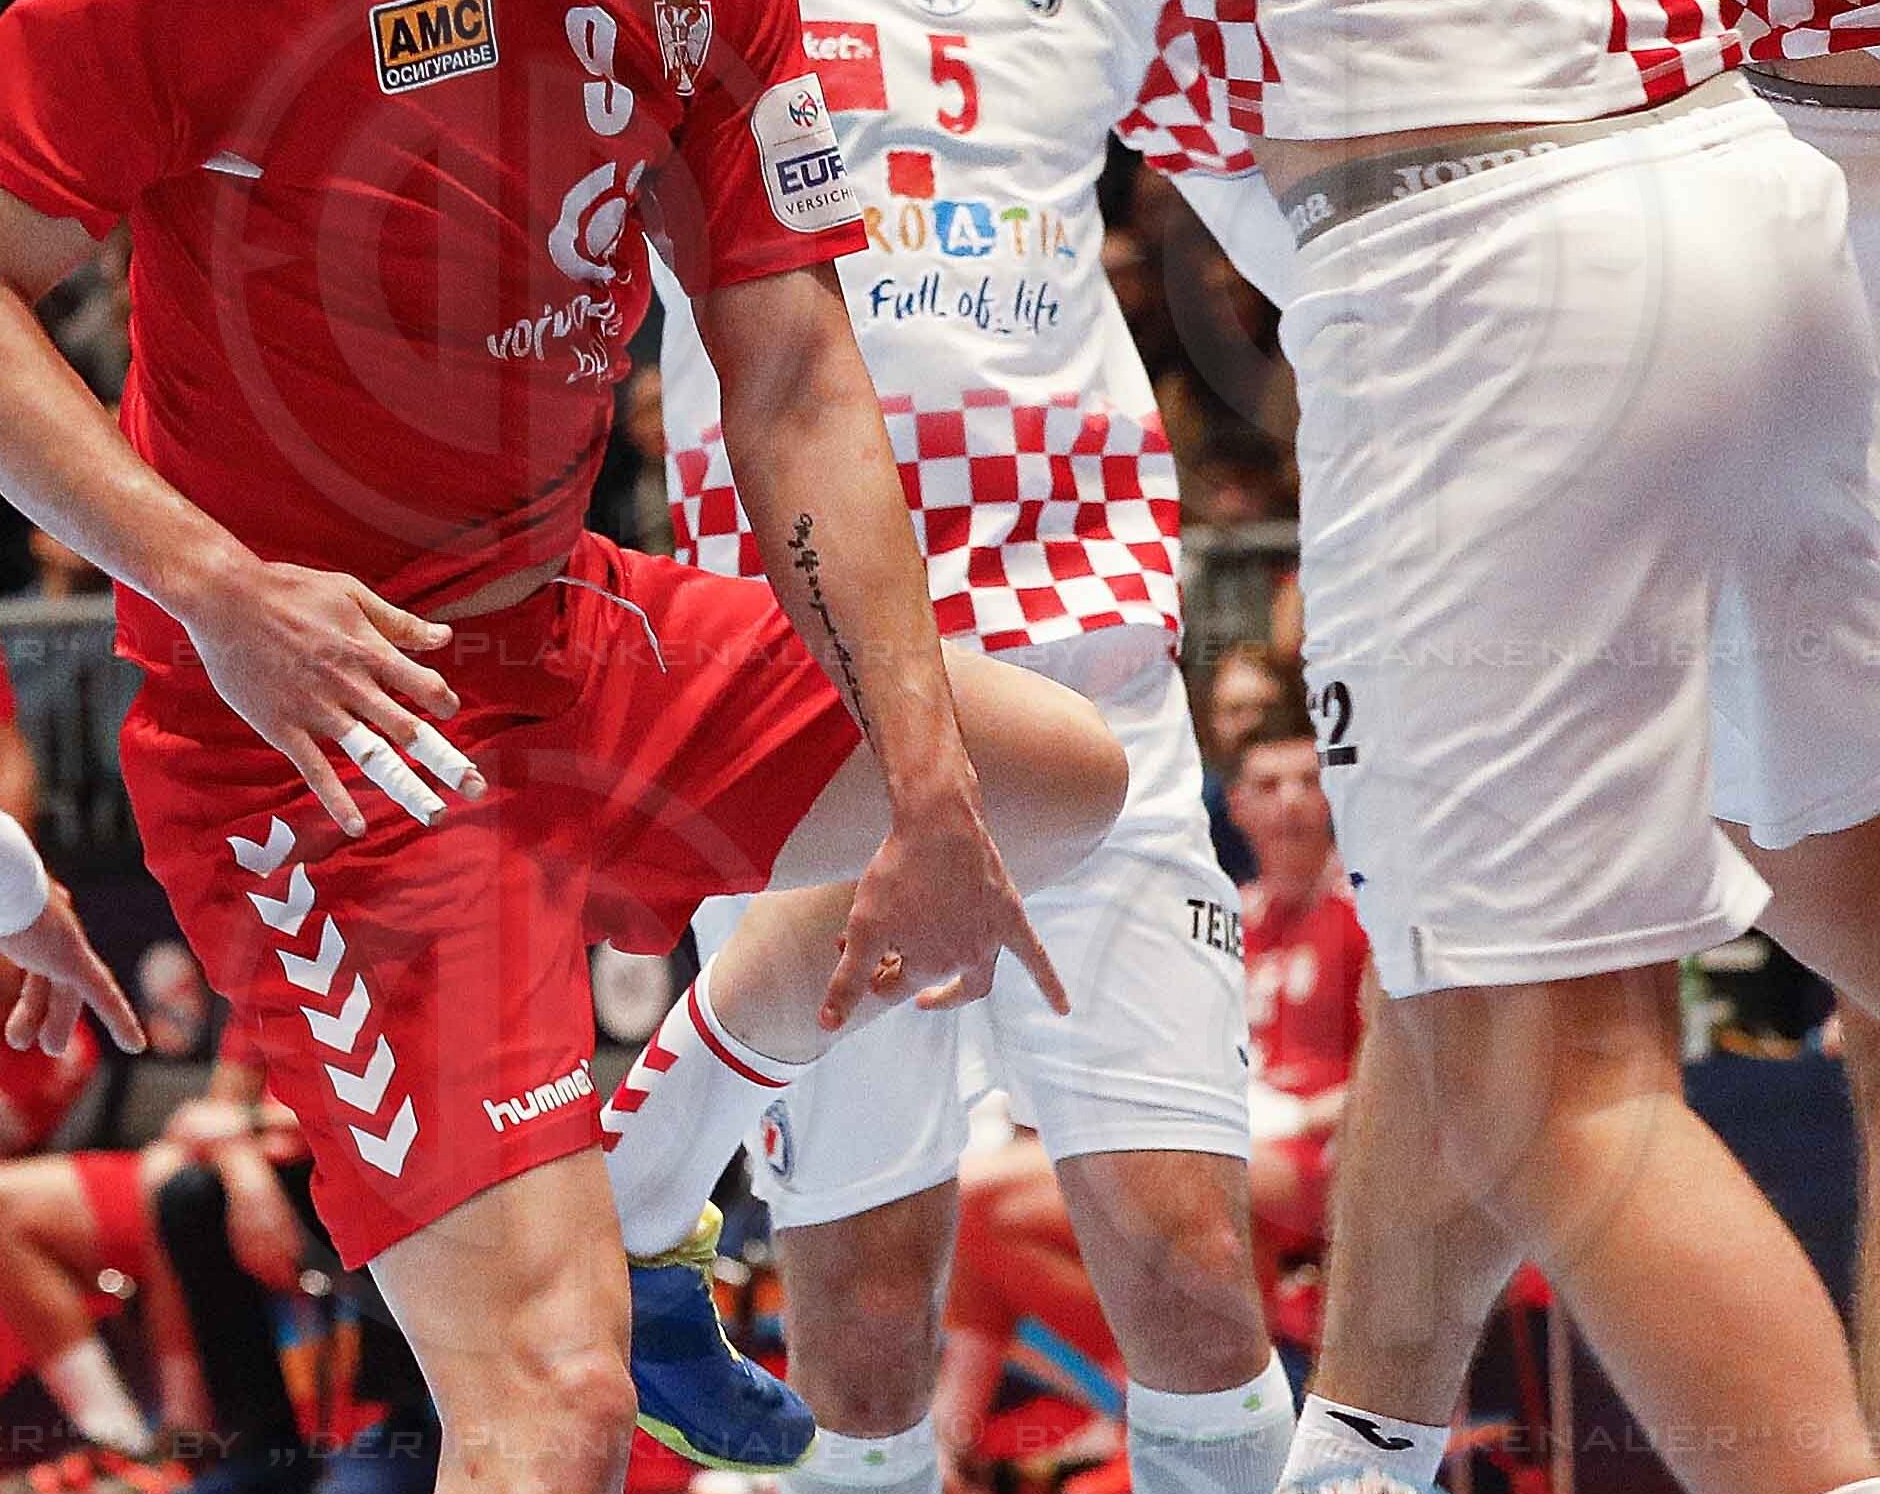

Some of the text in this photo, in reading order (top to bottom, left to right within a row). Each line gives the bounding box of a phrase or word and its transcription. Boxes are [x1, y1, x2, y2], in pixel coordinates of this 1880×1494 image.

[928, 34, 980, 135] 5
[775, 146, 848, 196] EUR
[785, 187, 856, 216] VERSICH
[864, 199, 1078, 258] ROATIA
[869, 273, 935, 320] Full
[1013, 279, 1061, 336] life
